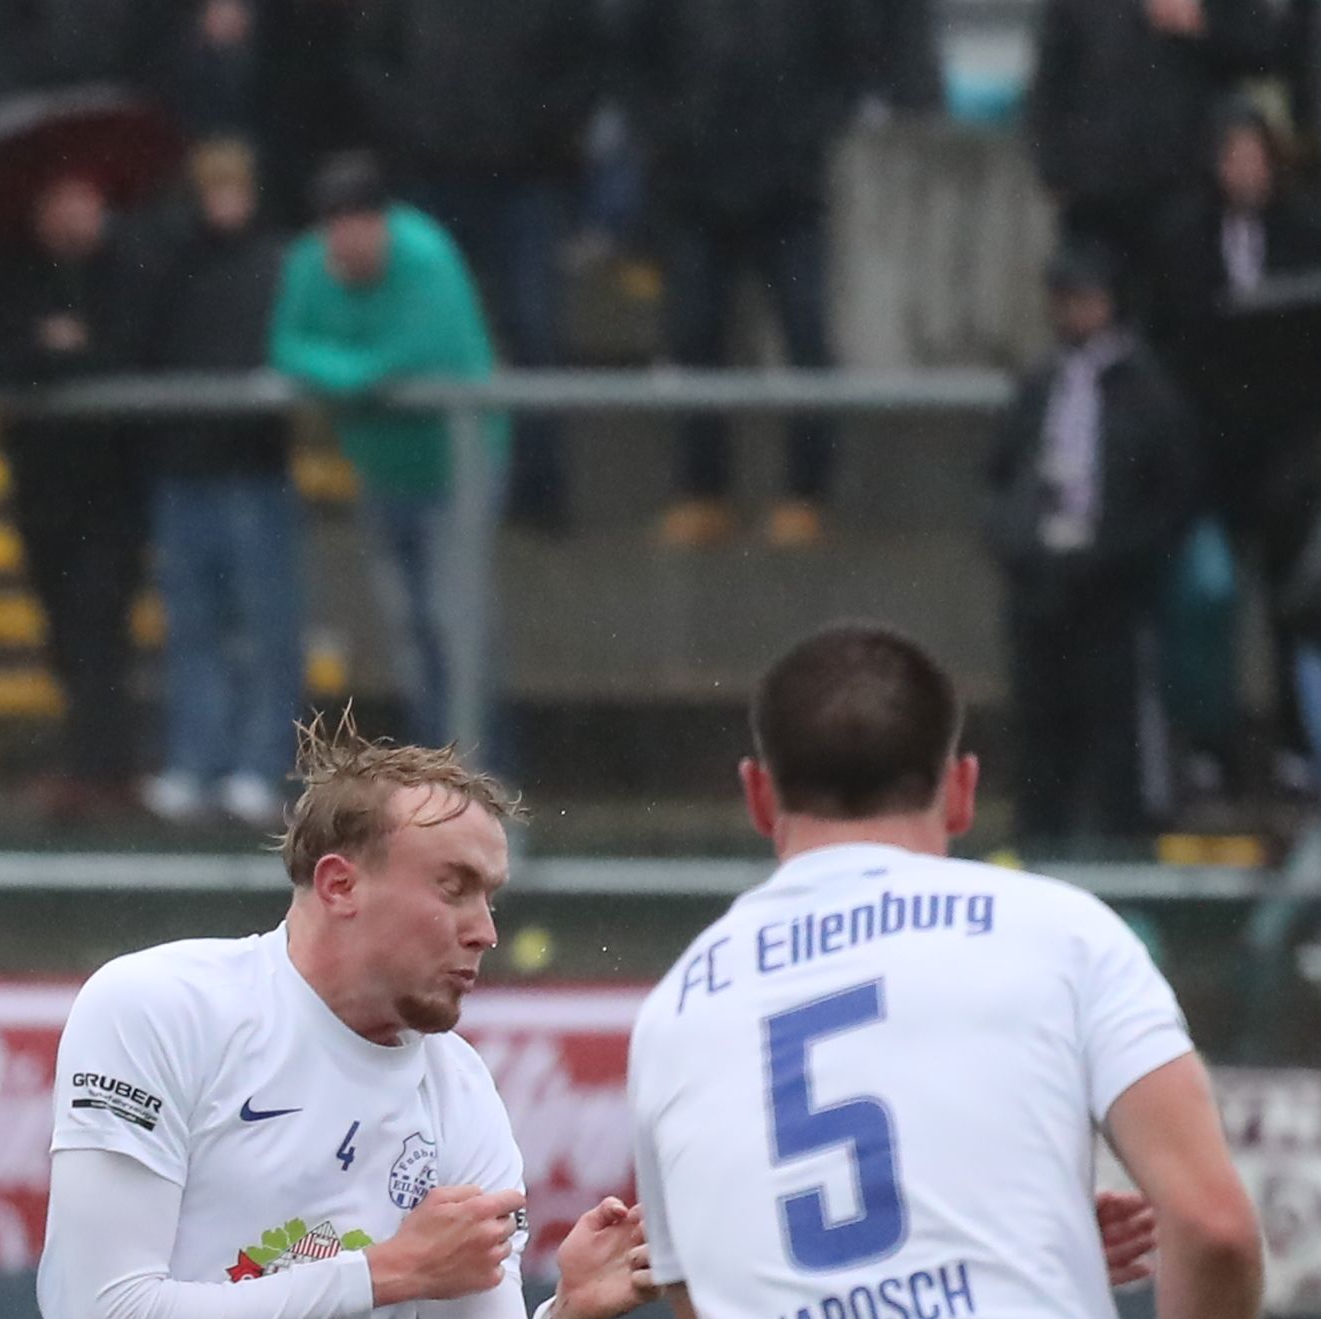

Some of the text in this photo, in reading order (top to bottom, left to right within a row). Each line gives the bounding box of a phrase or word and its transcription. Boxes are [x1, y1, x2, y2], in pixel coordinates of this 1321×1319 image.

[677, 890, 995, 1016] FC Eilenburg
[72, 1073, 163, 1115] GRUBER
[761, 976, 906, 1274] 5
[335, 1120, 360, 1172] 4
